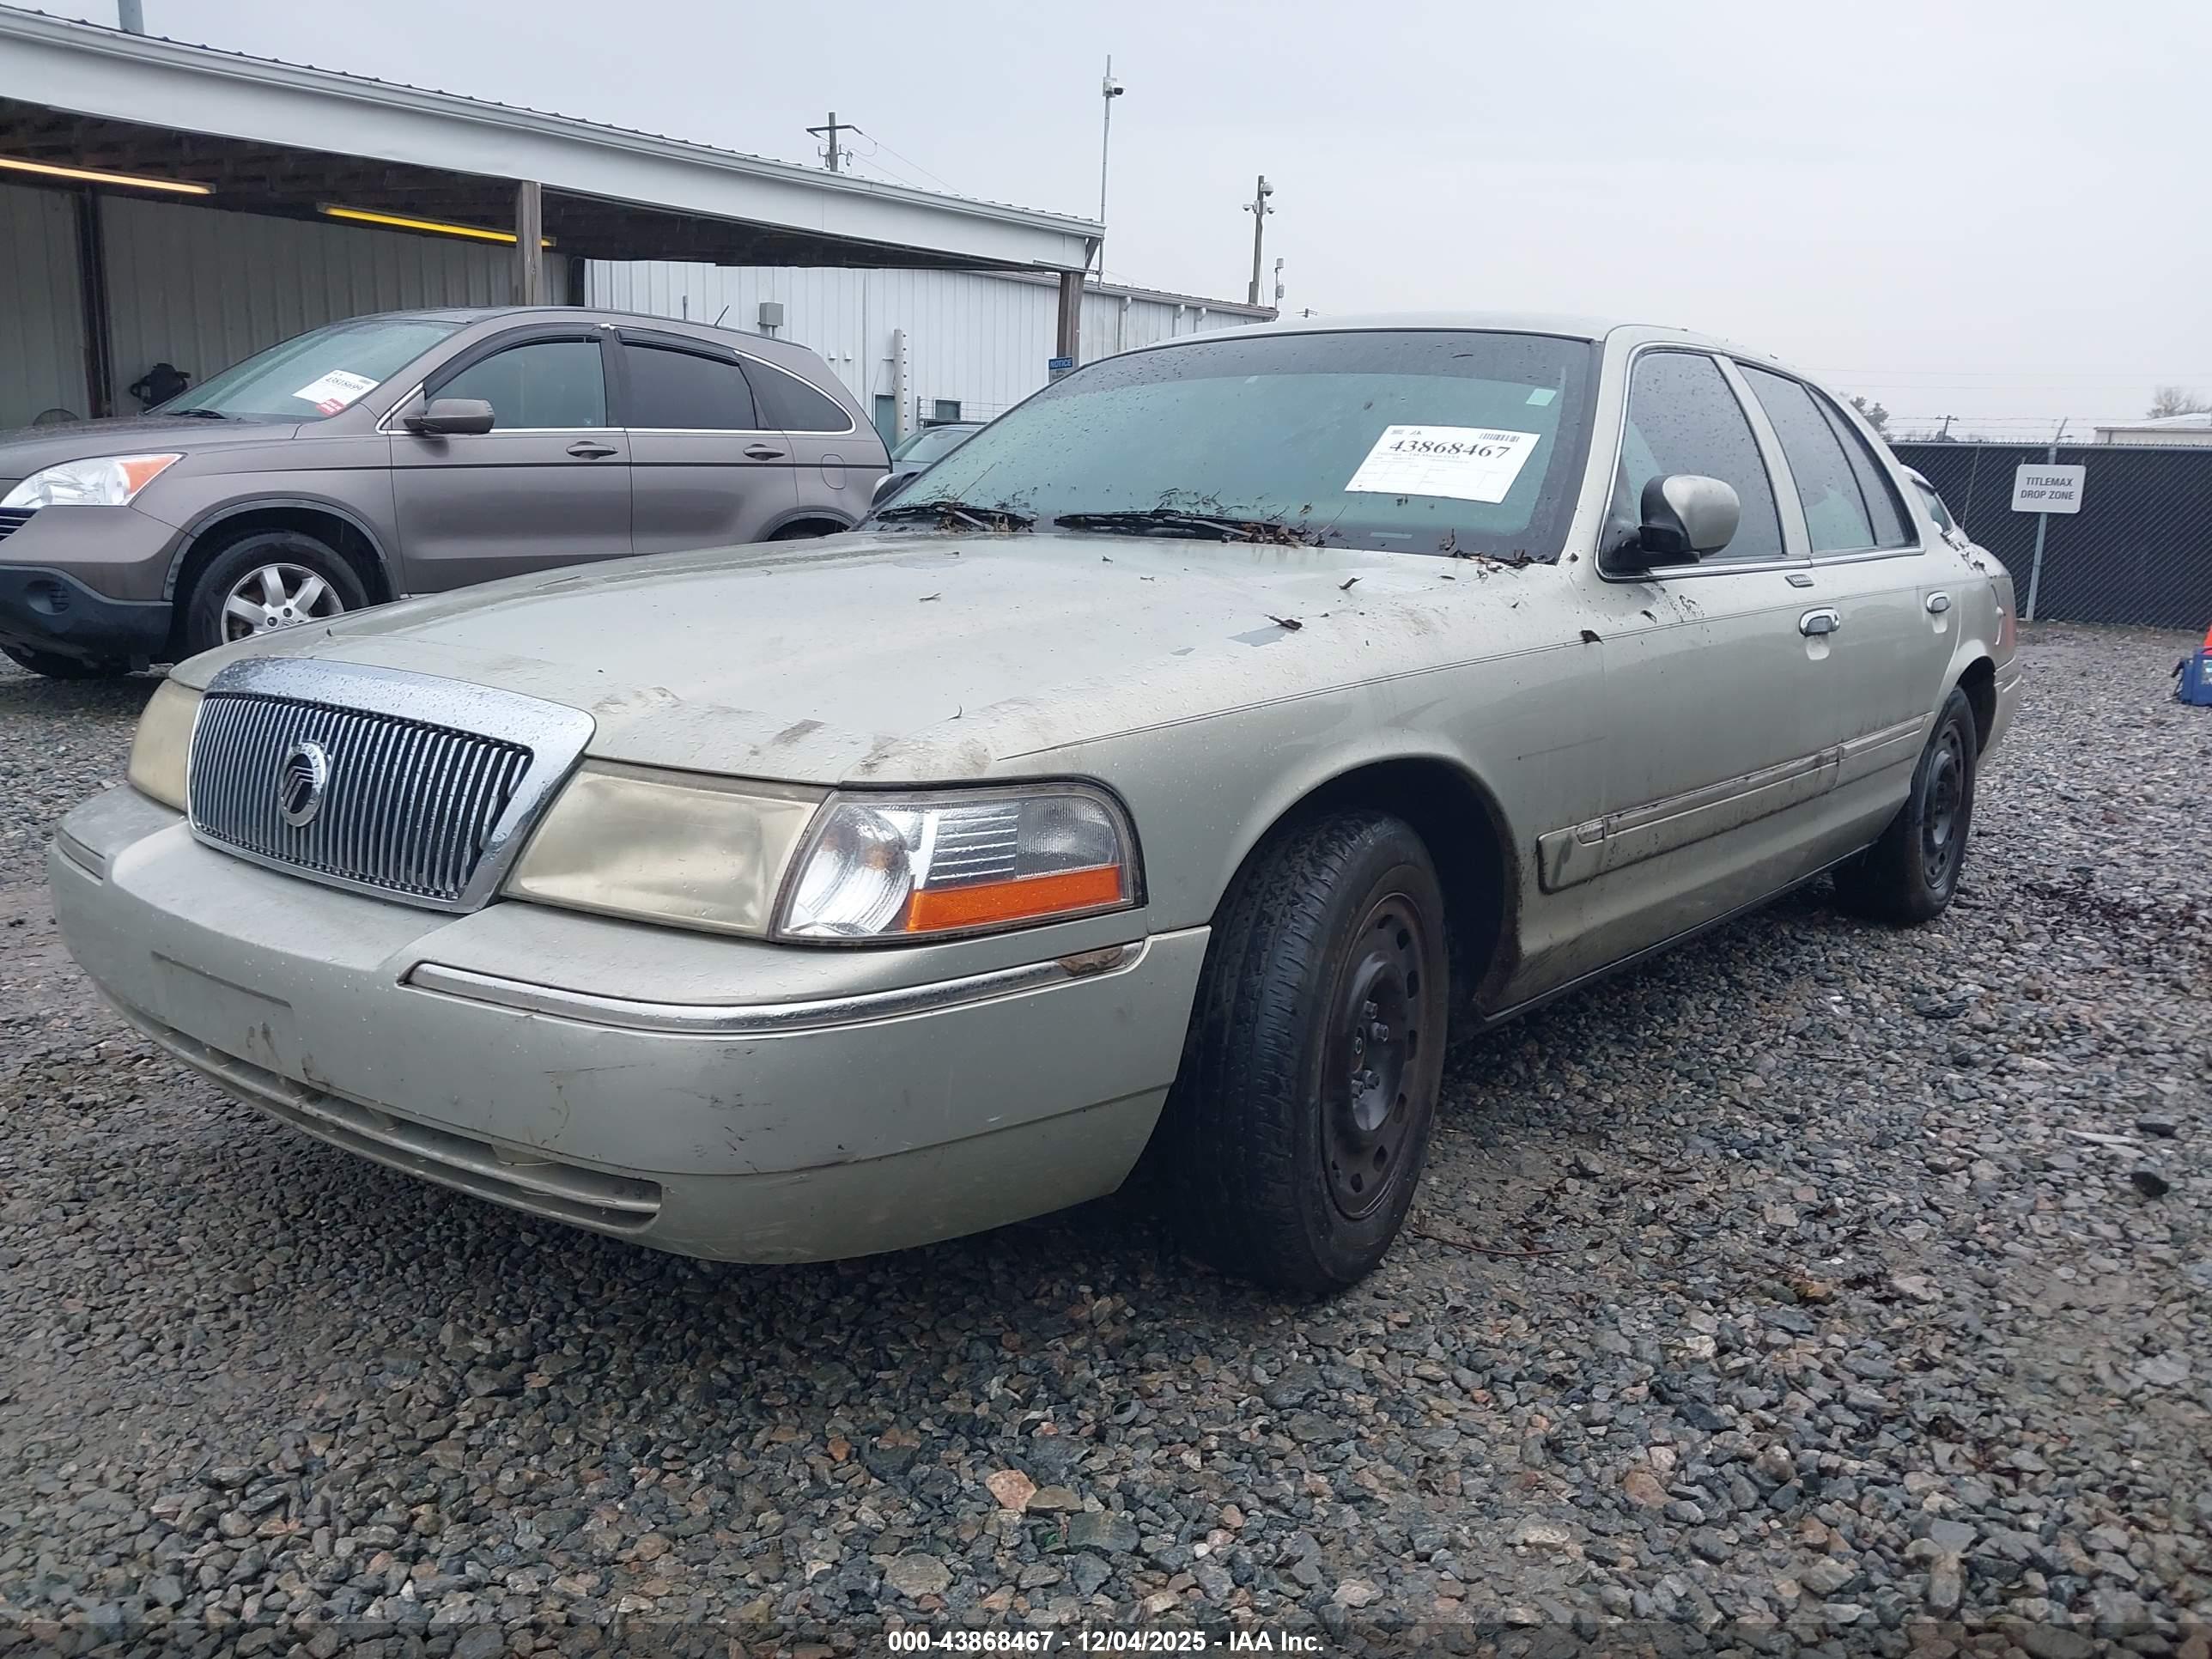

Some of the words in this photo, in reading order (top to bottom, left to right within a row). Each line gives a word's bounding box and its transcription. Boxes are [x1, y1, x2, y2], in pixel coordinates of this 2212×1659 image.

[1389, 440, 1510, 459] 43868467
[2027, 477, 2074, 486] TITLEMAX
[2021, 489, 2045, 499] DROP
[2047, 490, 2075, 500] ZONE
